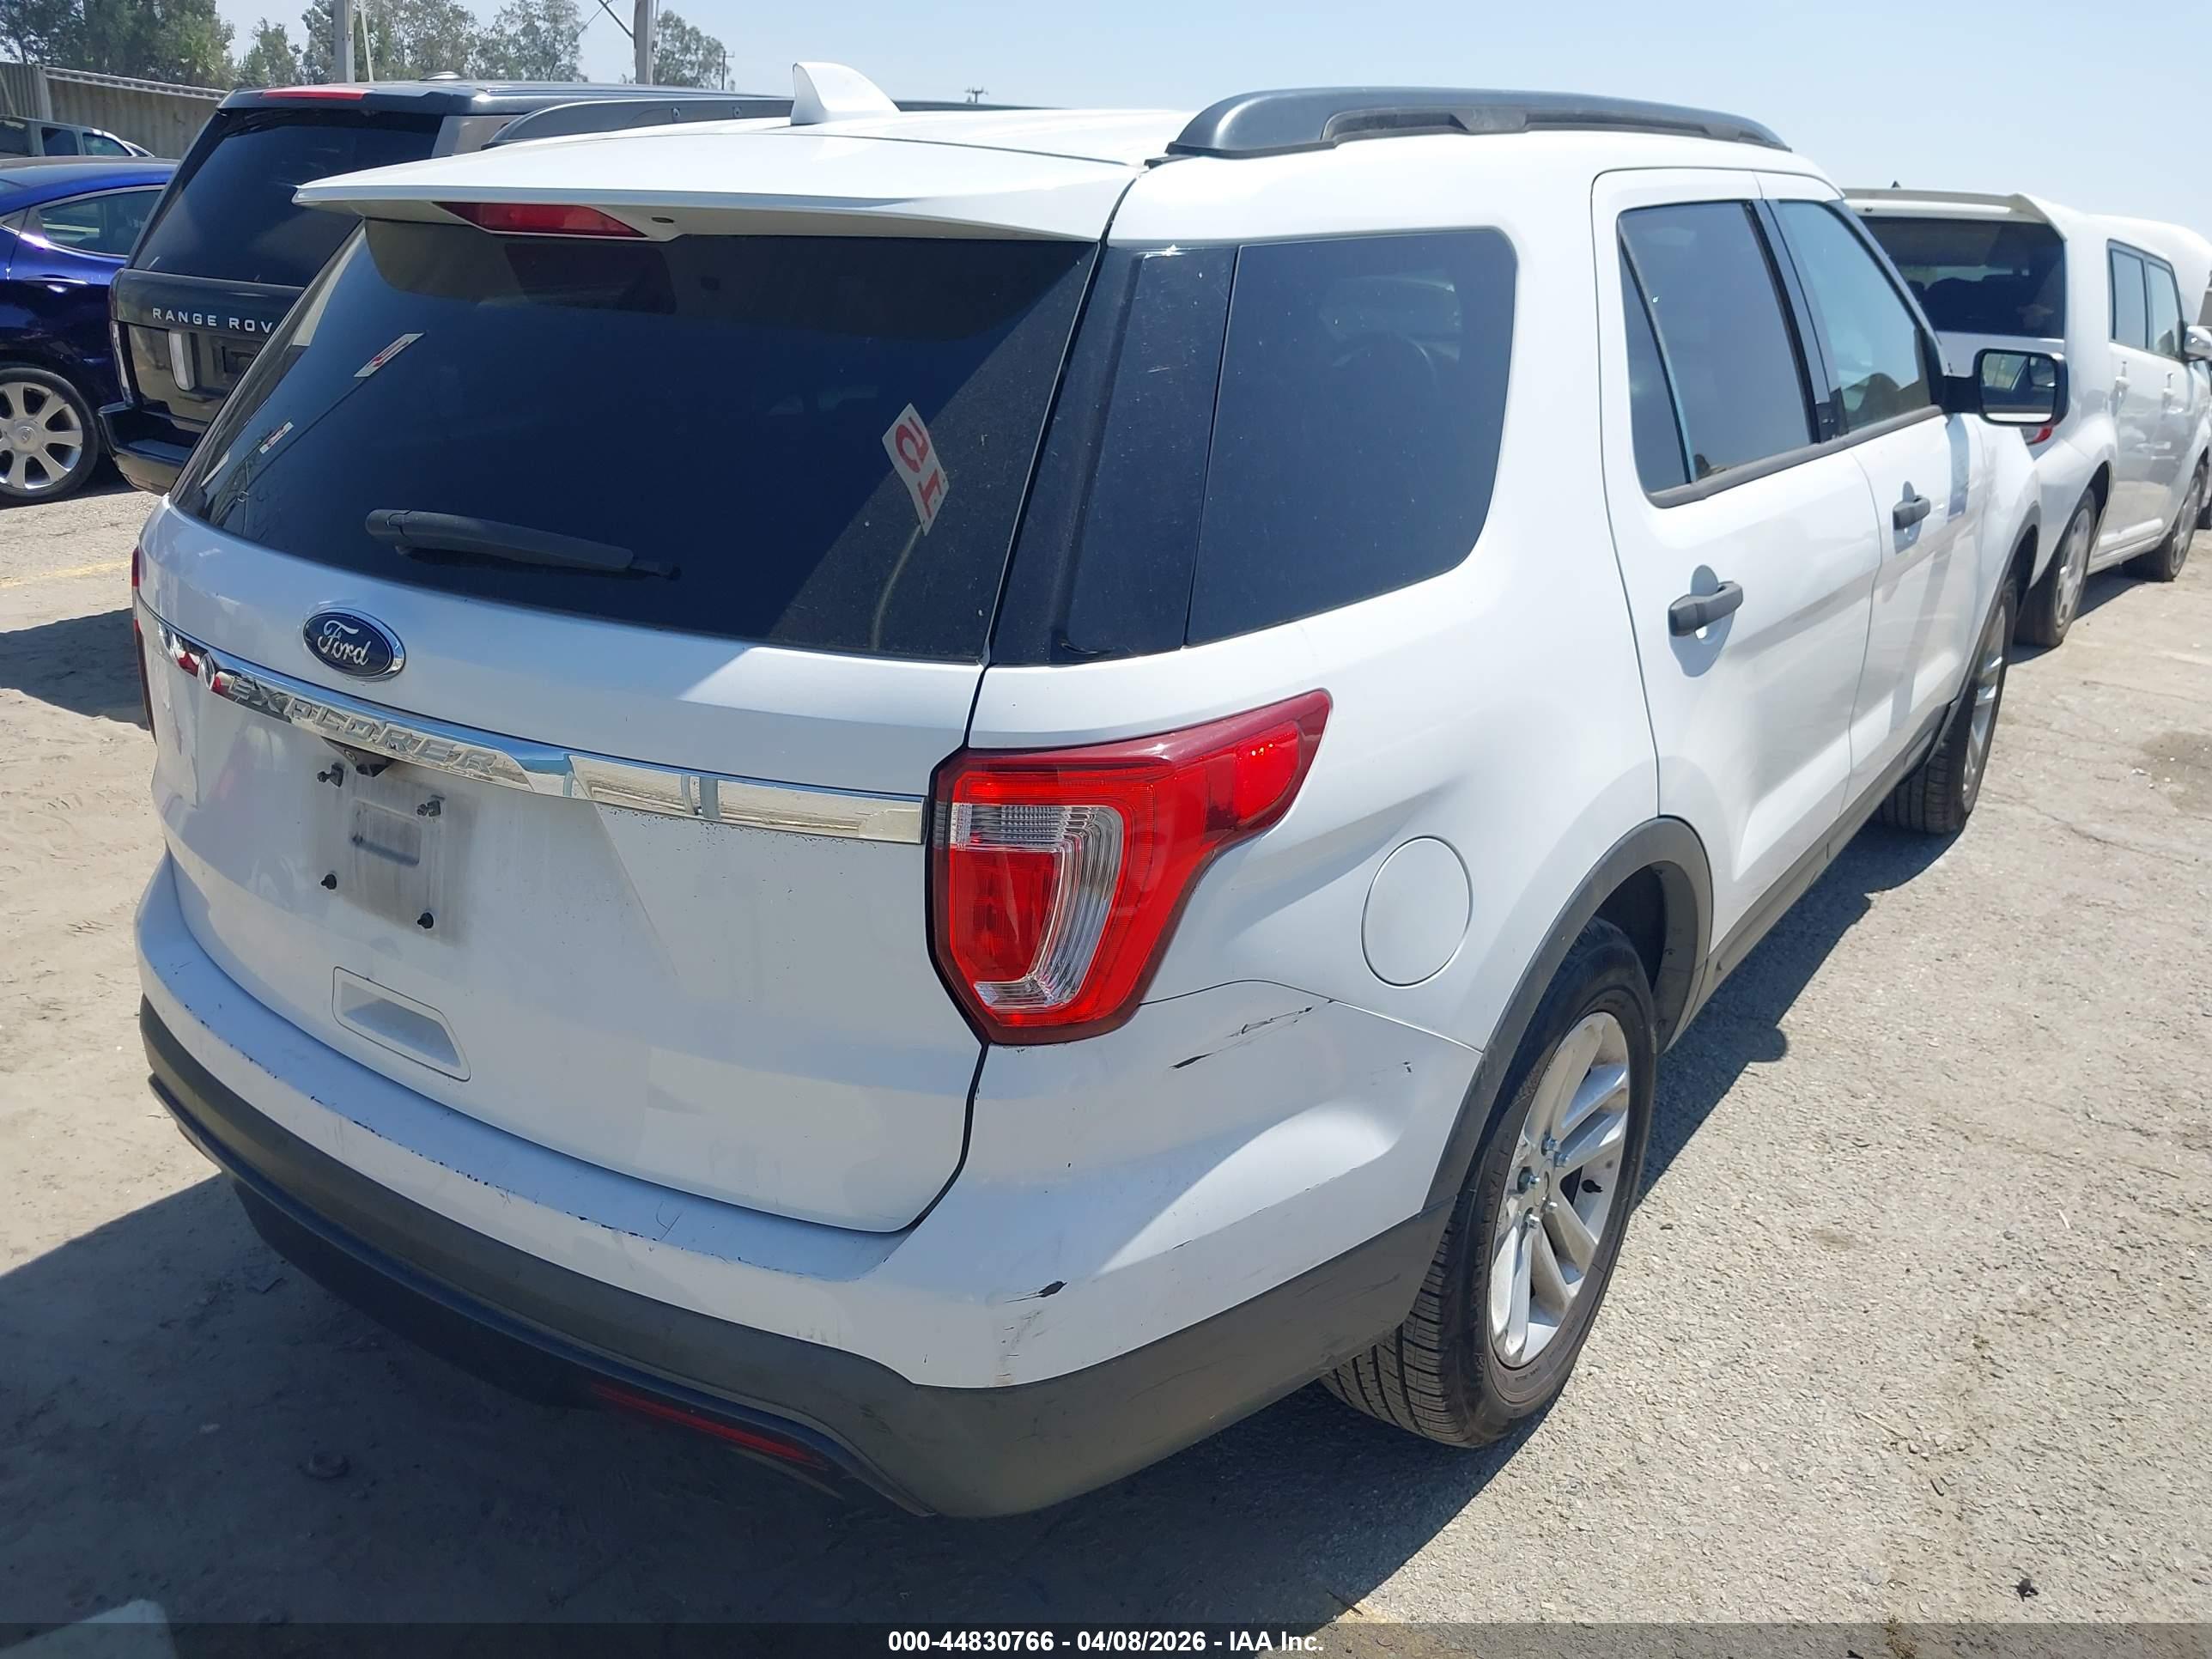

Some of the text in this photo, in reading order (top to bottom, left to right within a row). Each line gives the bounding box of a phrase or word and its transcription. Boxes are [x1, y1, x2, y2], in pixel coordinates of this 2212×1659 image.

[152, 307, 217, 326] RANGE
[317, 620, 372, 665] Ford
[227, 674, 498, 775] EXPLORER
